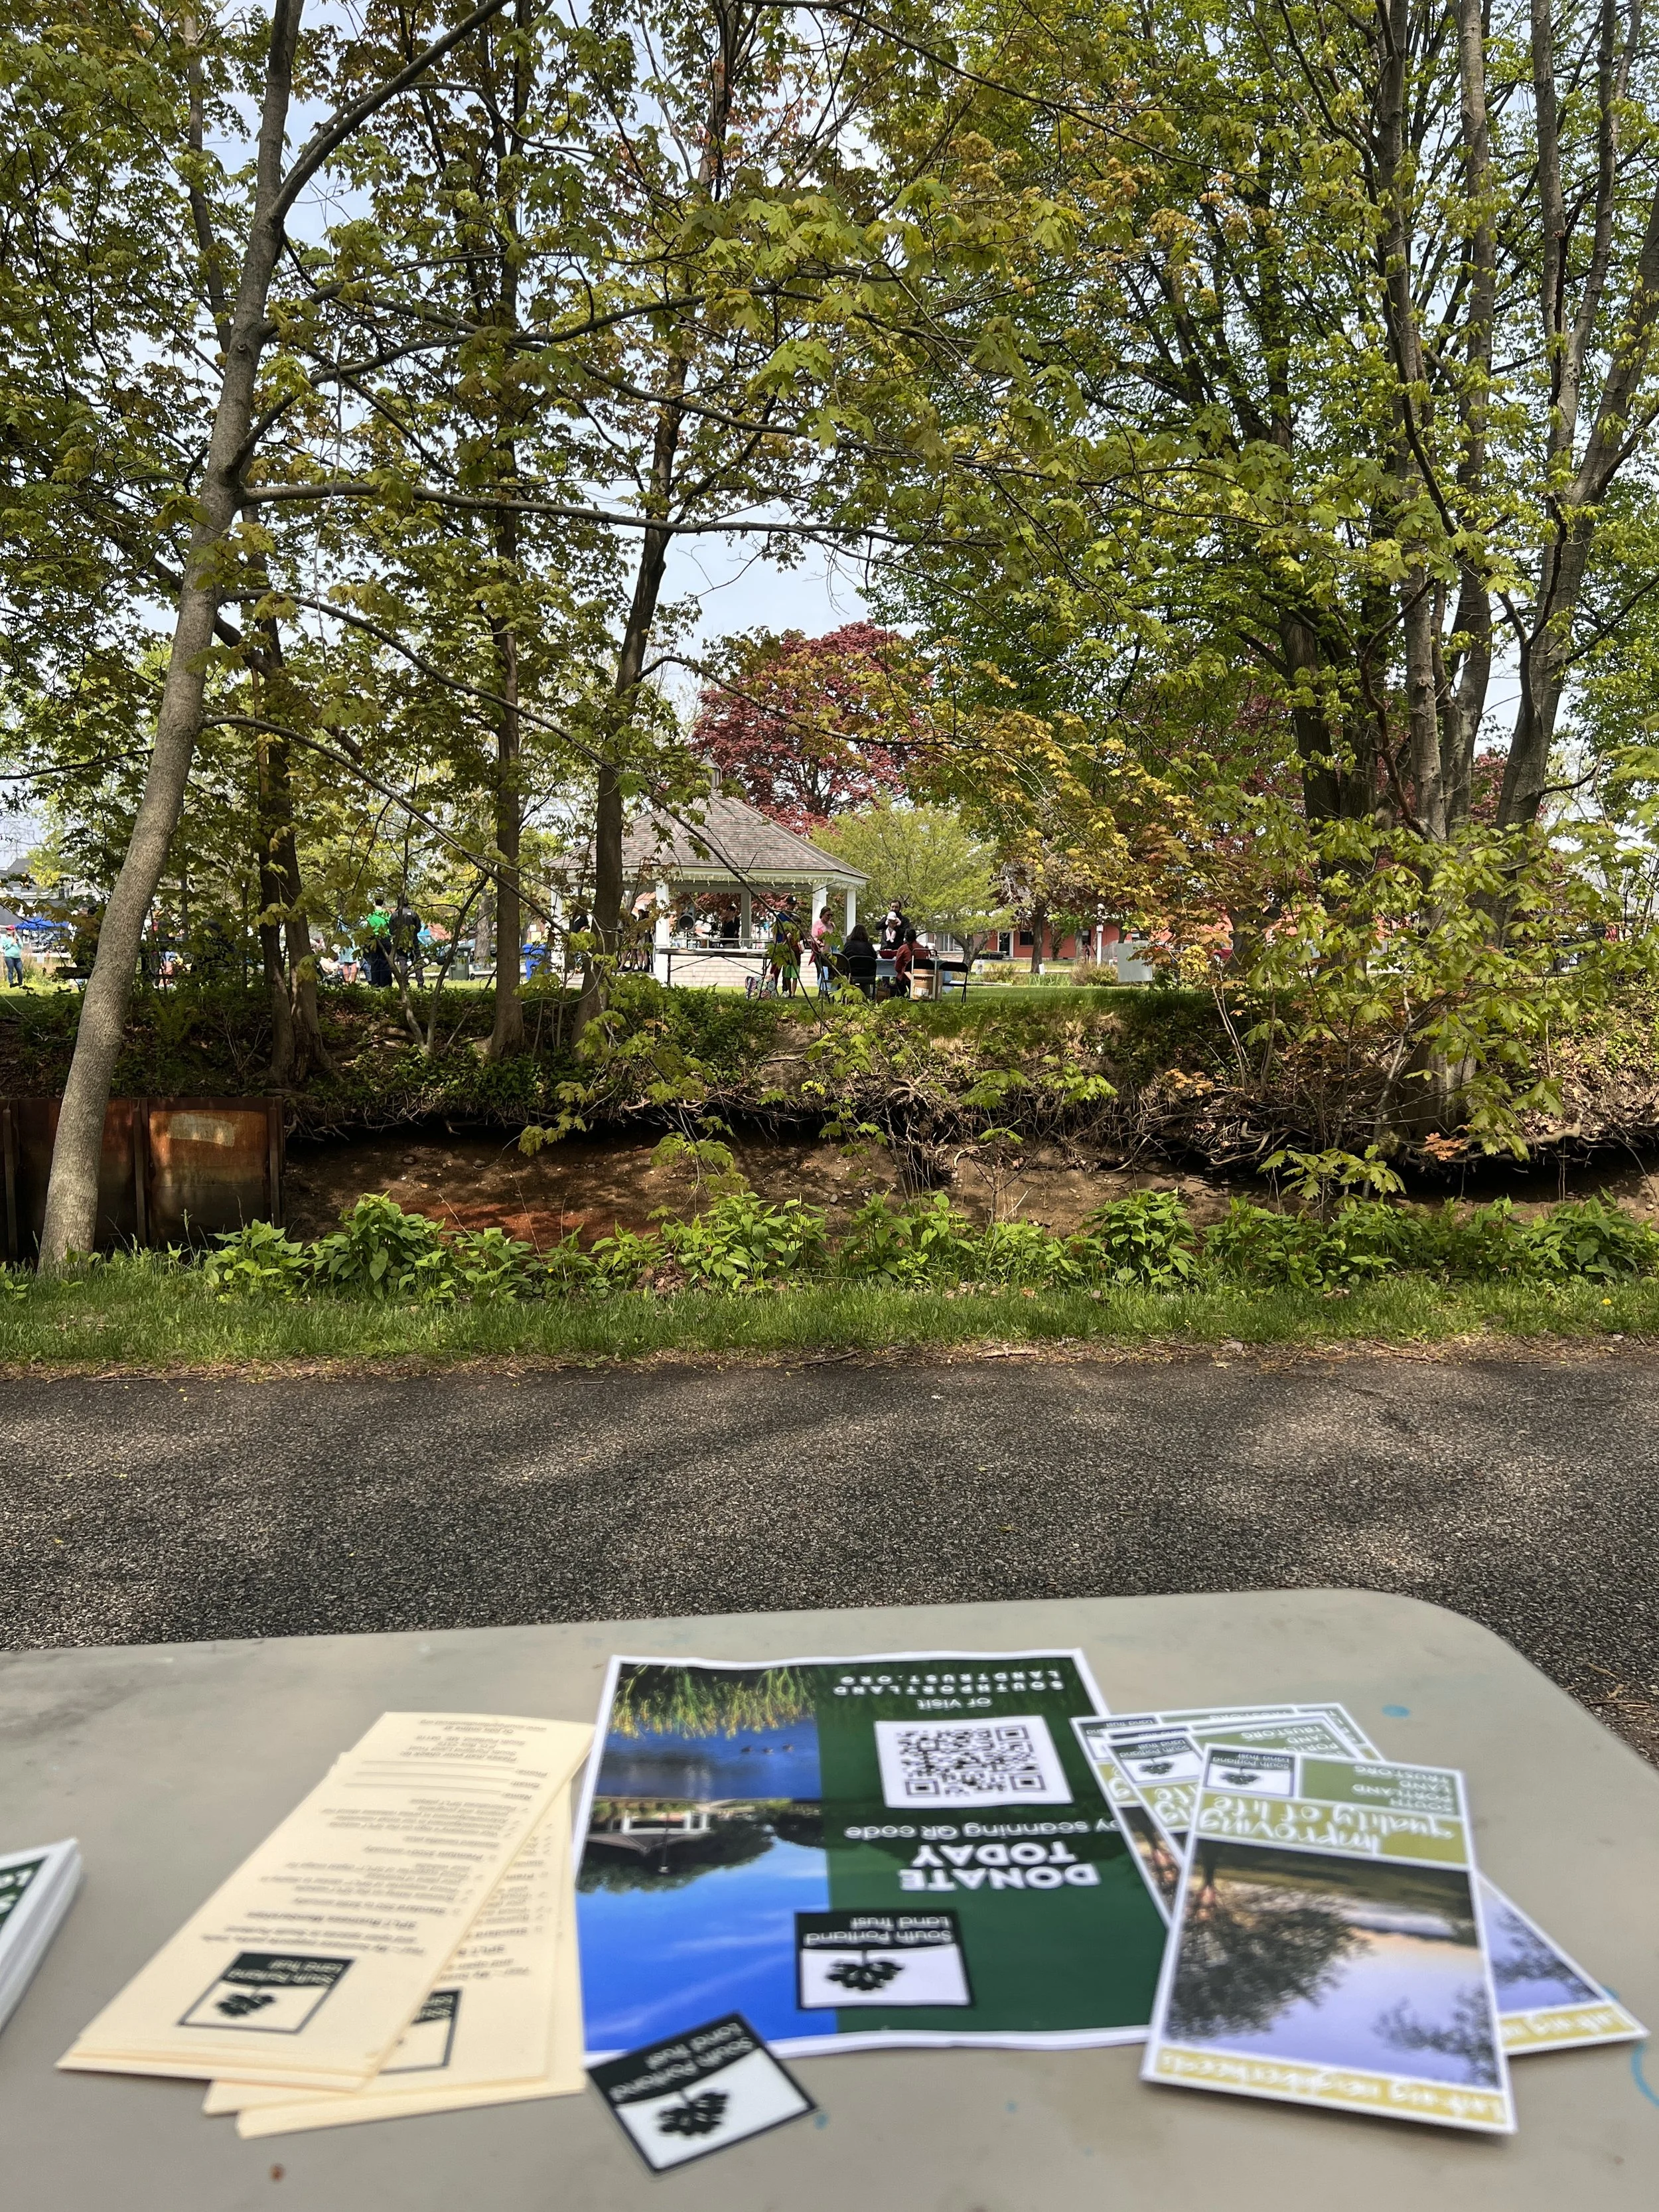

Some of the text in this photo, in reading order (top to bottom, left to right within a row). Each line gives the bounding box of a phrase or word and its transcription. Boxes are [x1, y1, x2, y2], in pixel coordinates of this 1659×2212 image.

[916, 1696, 991, 1710] or visit
[1287, 1733, 1330, 1744] LAND
[1119, 1748, 1160, 1758] Portland
[1212, 1757, 1257, 1767] Portland
[1352, 1784, 1451, 1802] PORTLAND
[1400, 1780, 1449, 1793] LAND
[1213, 1796, 1268, 1818] life
[1279, 1803, 1321, 1824] of
[963, 1820, 1089, 1838] scanning
[1334, 1805, 1454, 1840] quality
[844, 1824, 916, 1841] code
[920, 1824, 958, 1840] QR
[1198, 1808, 1378, 1856] Improving
[912, 1840, 1077, 1868] TODAY
[898, 1863, 1100, 1891] DONATE
[849, 1915, 950, 1931] Land Trust
[803, 1929, 952, 1947] South Portland
[644, 2023, 743, 2070] Land Trust
[610, 2036, 753, 2103] South Portland
